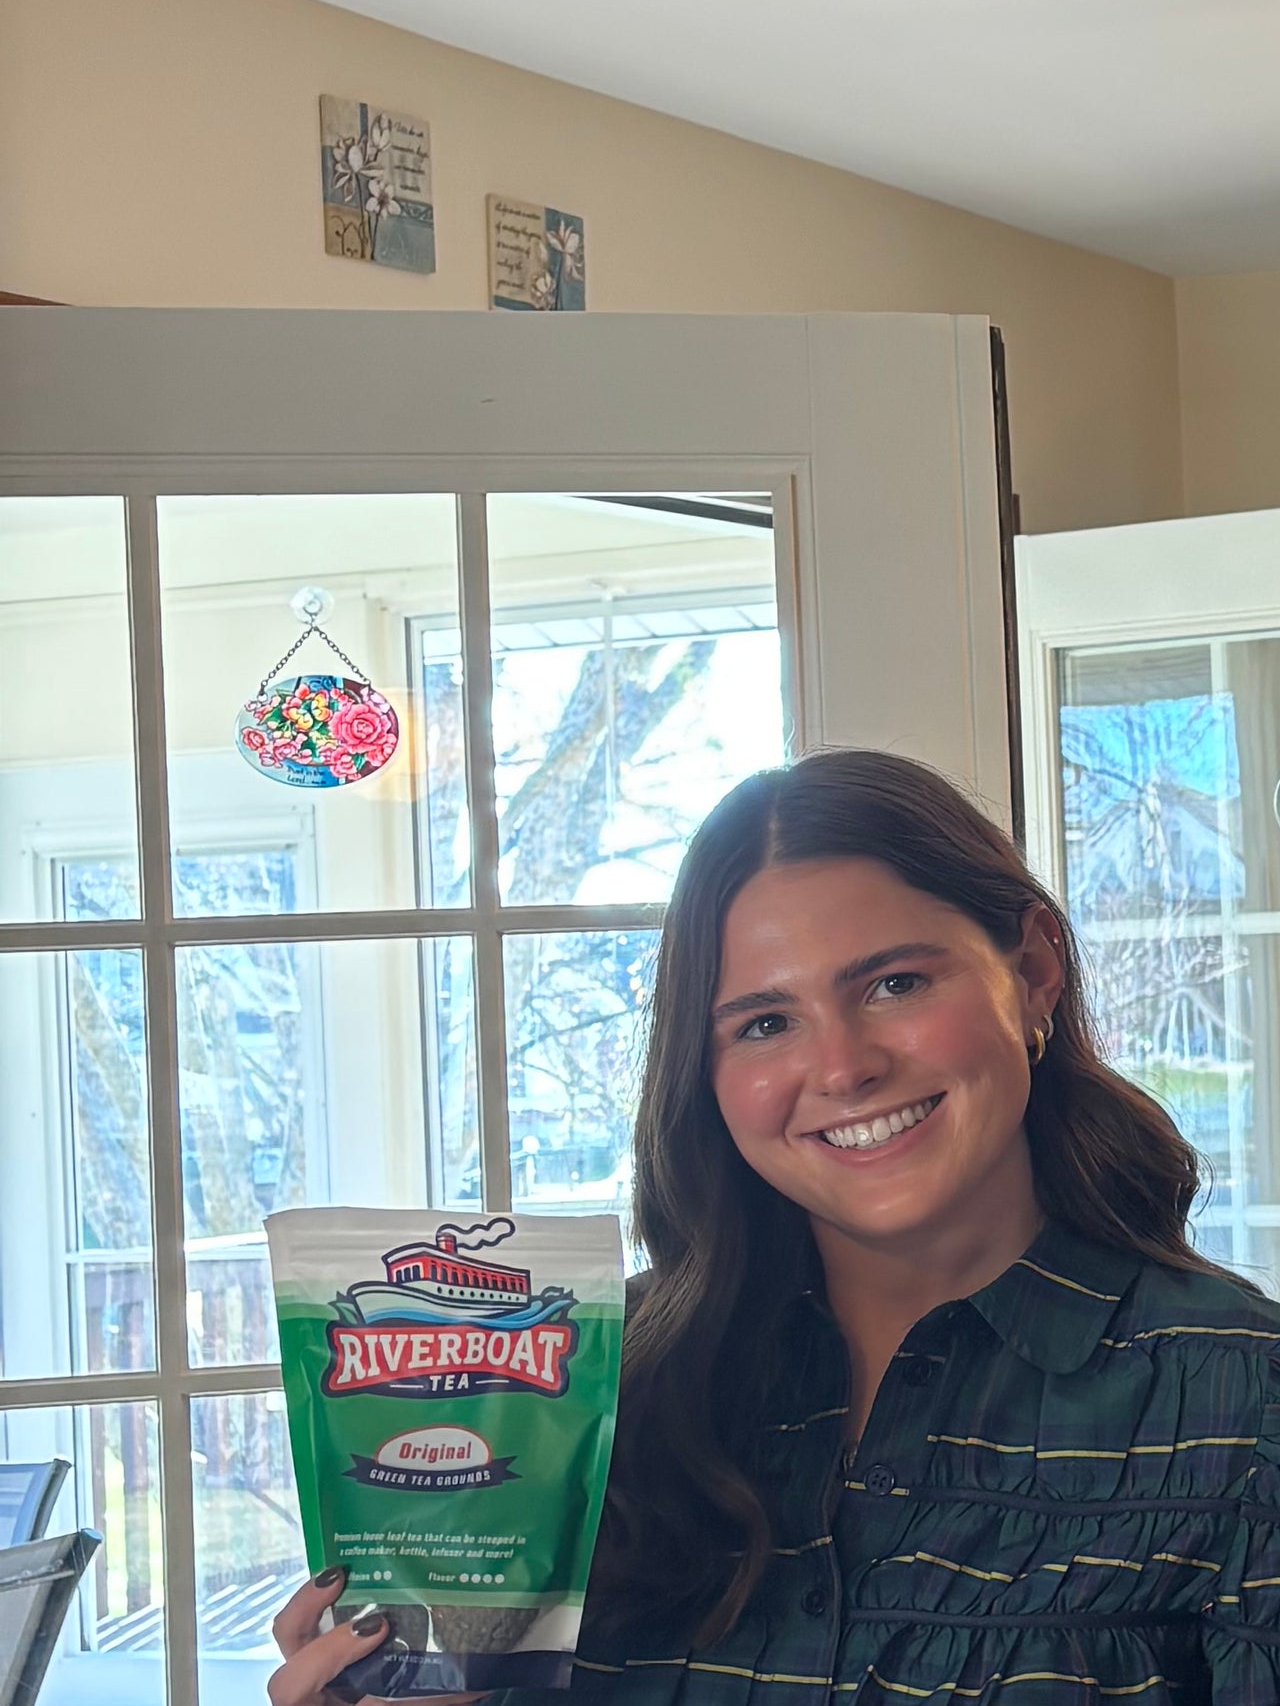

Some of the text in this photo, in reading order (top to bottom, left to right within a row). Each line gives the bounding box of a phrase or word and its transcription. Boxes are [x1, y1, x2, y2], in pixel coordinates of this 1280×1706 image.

[337, 1330, 565, 1384] RIVERBOAT
[429, 1373, 469, 1392] TEA
[399, 1441, 472, 1464] Original
[369, 1468, 491, 1486] GREEN TEA GROUNDS
[387, 1531, 406, 1542] leaf
[407, 1533, 422, 1542] tea
[424, 1533, 444, 1543] that
[445, 1535, 461, 1543] can
[463, 1533, 475, 1544] be
[477, 1535, 516, 1546] steeped
[517, 1535, 526, 1544] in
[399, 1546, 429, 1557] kettle,
[431, 1547, 464, 1557] infuser
[466, 1549, 485, 1558] and
[485, 1549, 514, 1558] more!
[428, 1572, 456, 1582] Flavor
